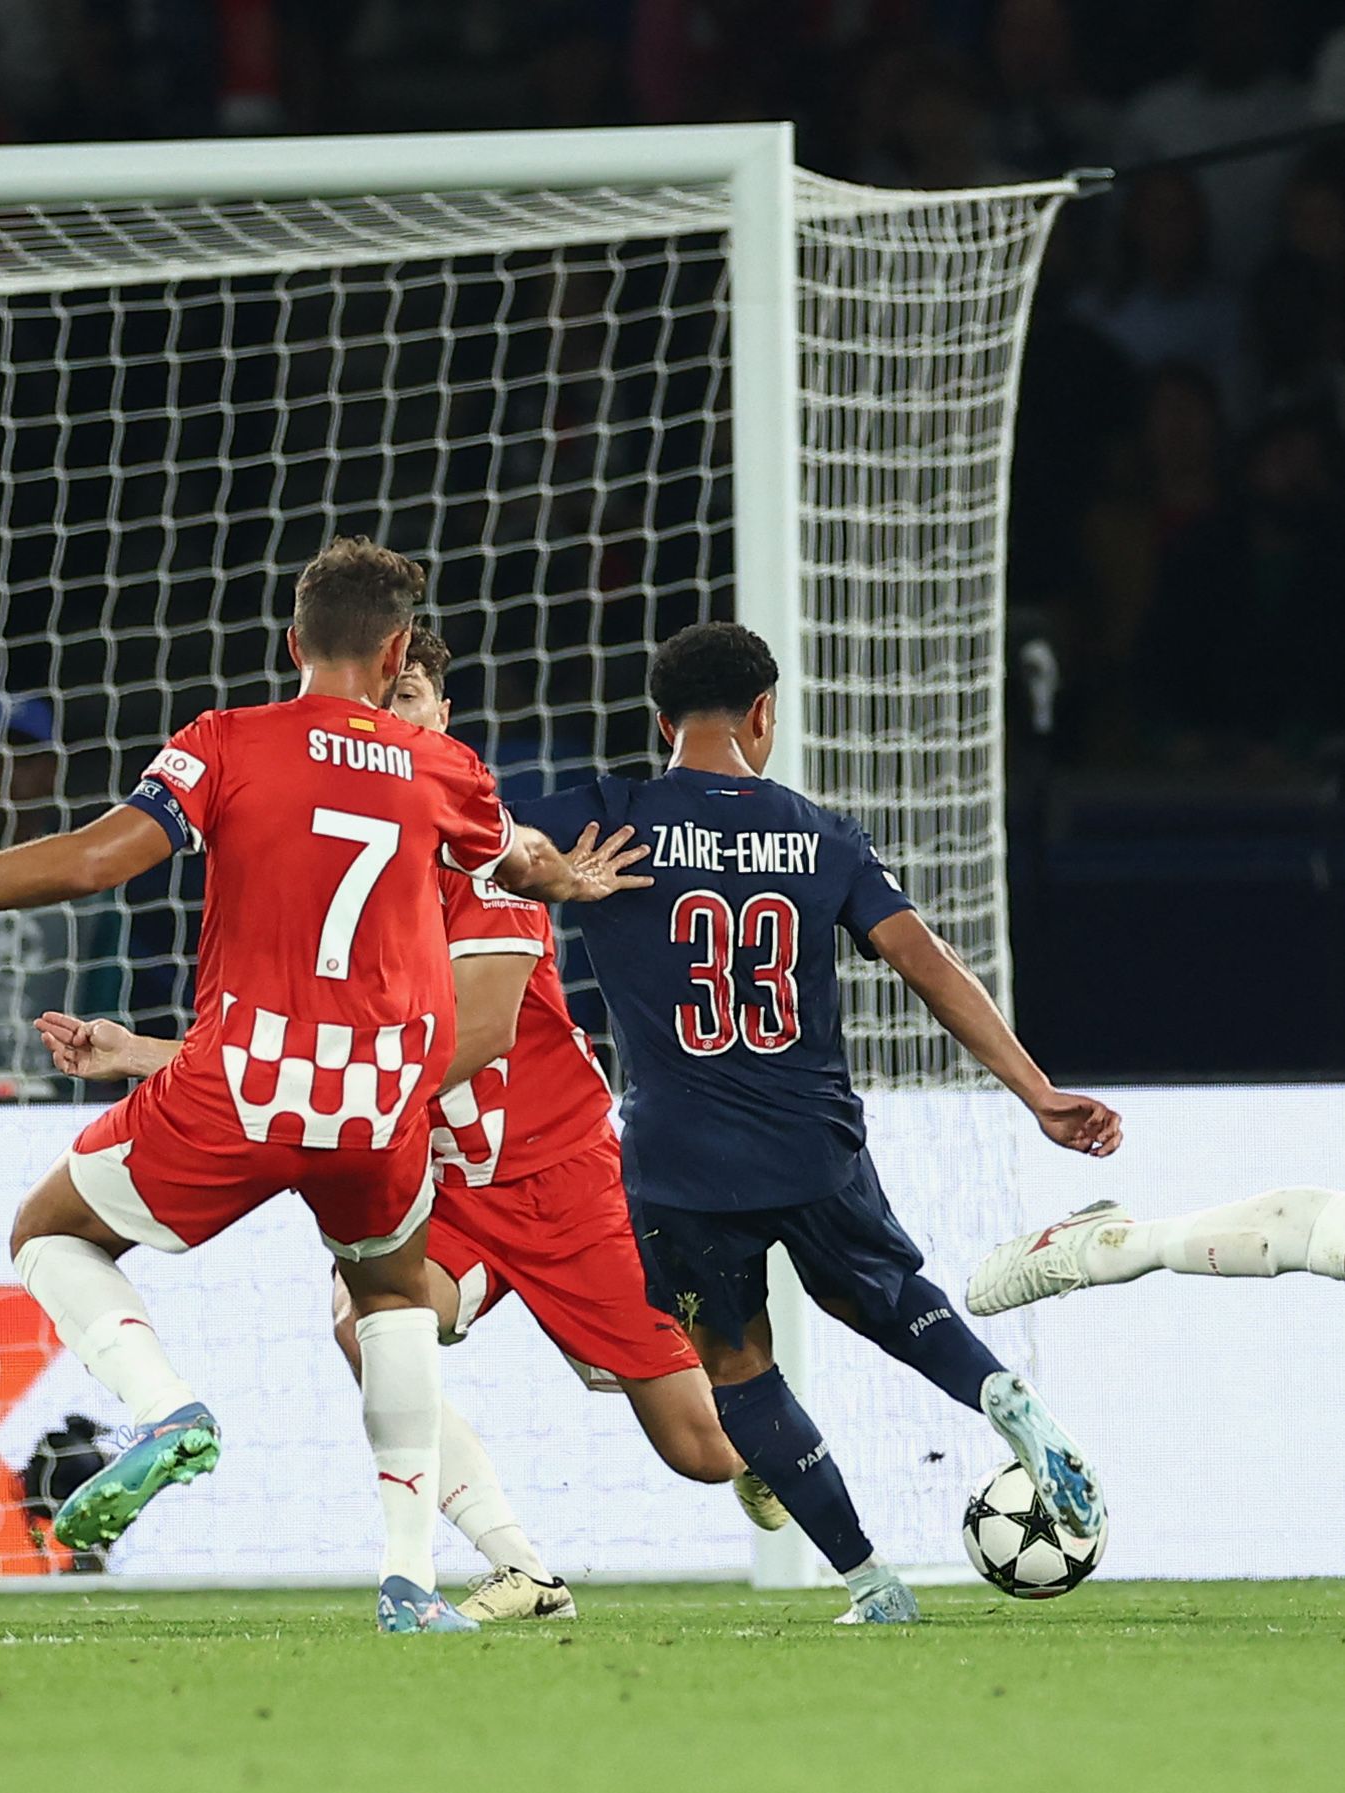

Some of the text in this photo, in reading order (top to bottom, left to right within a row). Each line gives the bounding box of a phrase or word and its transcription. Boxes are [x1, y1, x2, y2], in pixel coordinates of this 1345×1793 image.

[308, 728, 413, 781] STUANI
[652, 821, 820, 875] ZAÏRE-EMERY
[311, 807, 402, 981] 7
[670, 889, 801, 1057] 33
[909, 1308, 952, 1337] PARIS
